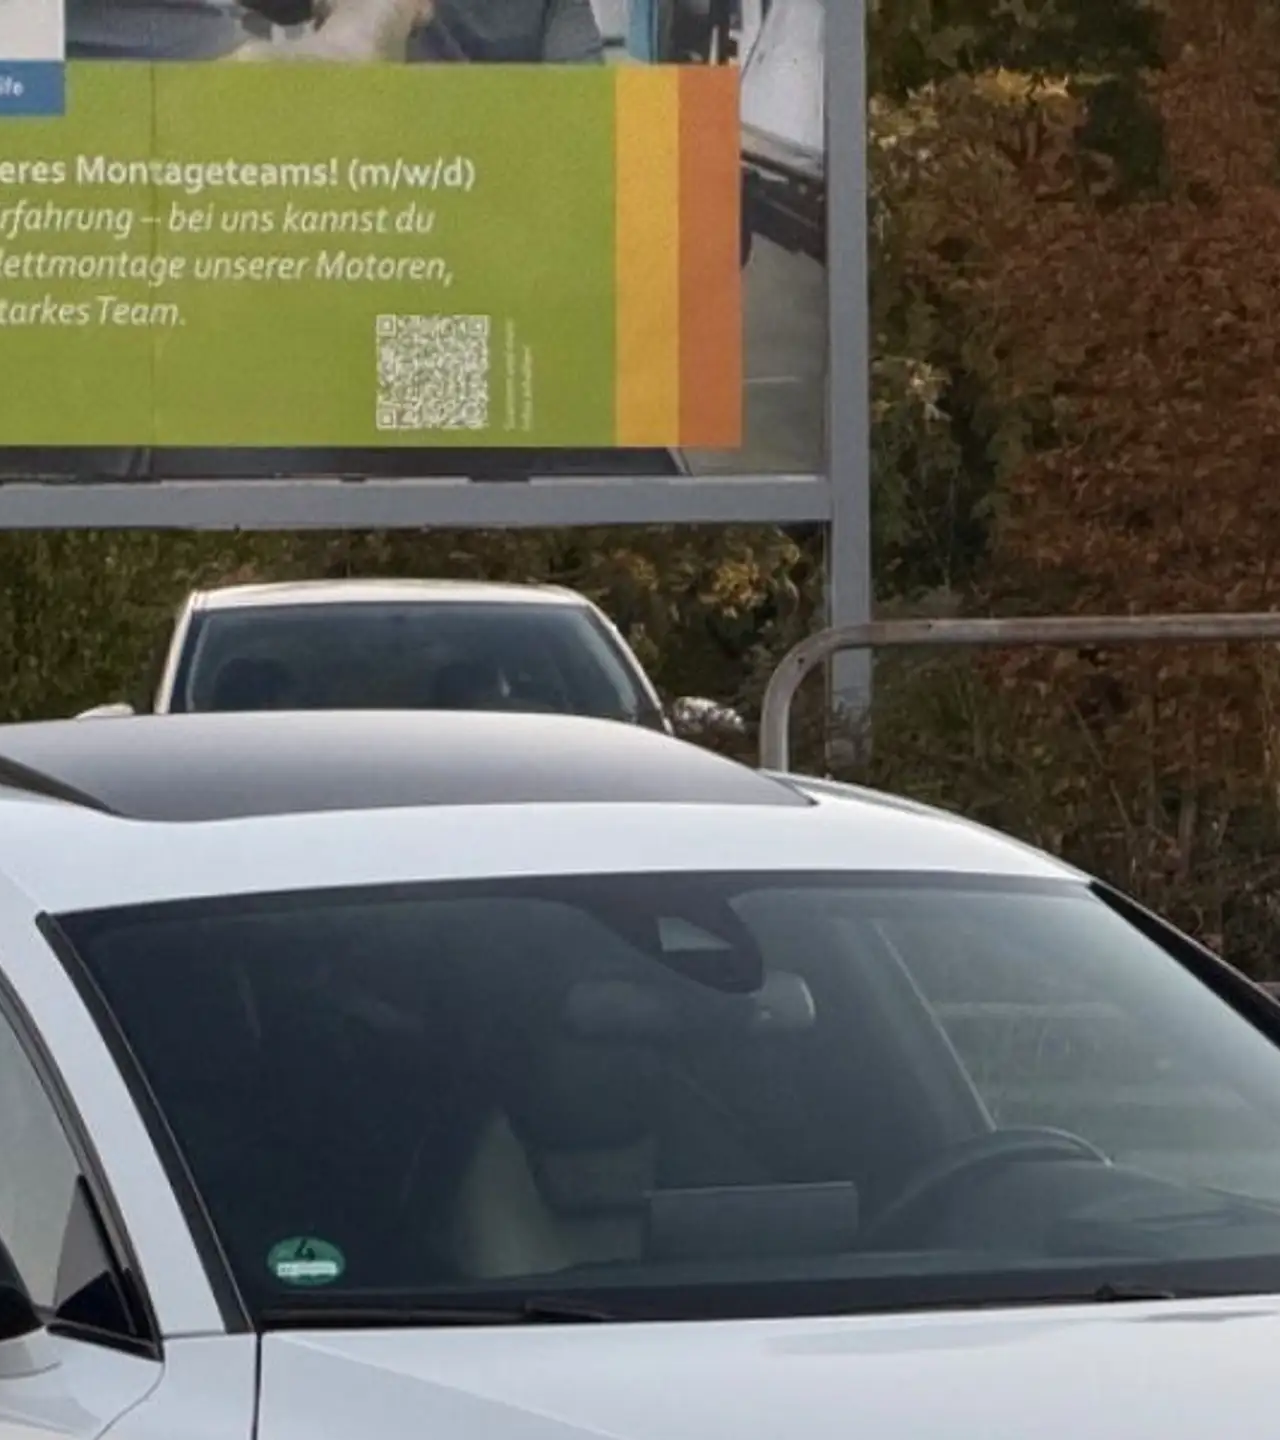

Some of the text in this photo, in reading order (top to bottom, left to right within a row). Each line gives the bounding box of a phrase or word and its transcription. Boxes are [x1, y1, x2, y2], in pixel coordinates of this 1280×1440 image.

[76, 155, 338, 194] Montageteams!
[348, 155, 476, 192] (m/w/d)
[168, 201, 214, 233] bei
[220, 210, 275, 233] uns
[282, 203, 389, 233] kannst
[395, 201, 436, 234] du
[193, 256, 310, 280] unserer
[315, 250, 454, 286] Motoren,
[97, 295, 186, 327] Team.
